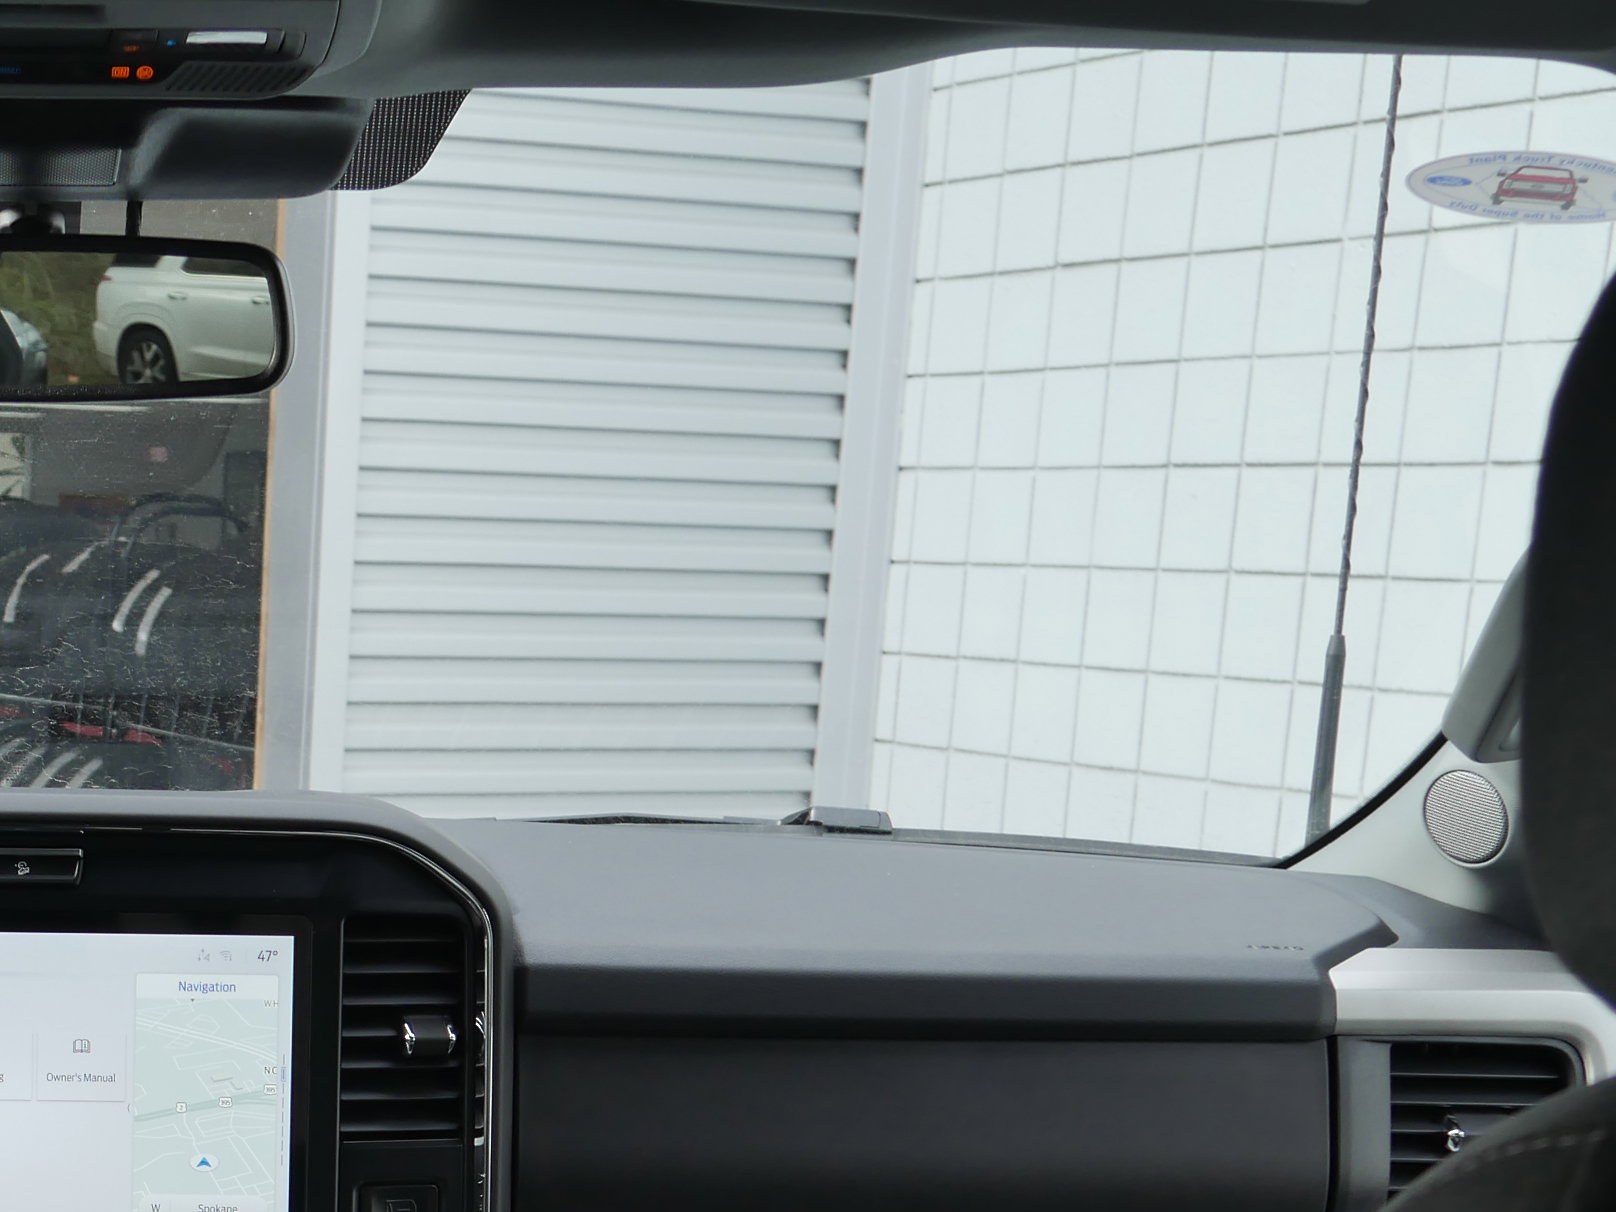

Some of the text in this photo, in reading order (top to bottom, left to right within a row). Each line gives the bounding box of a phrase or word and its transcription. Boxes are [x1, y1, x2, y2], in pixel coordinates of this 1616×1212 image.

[257, 949, 278, 962] 47°
[178, 981, 236, 994] Navigation
[46, 1072, 116, 1083] Owner's Manual
[151, 1204, 161, 1212] W
